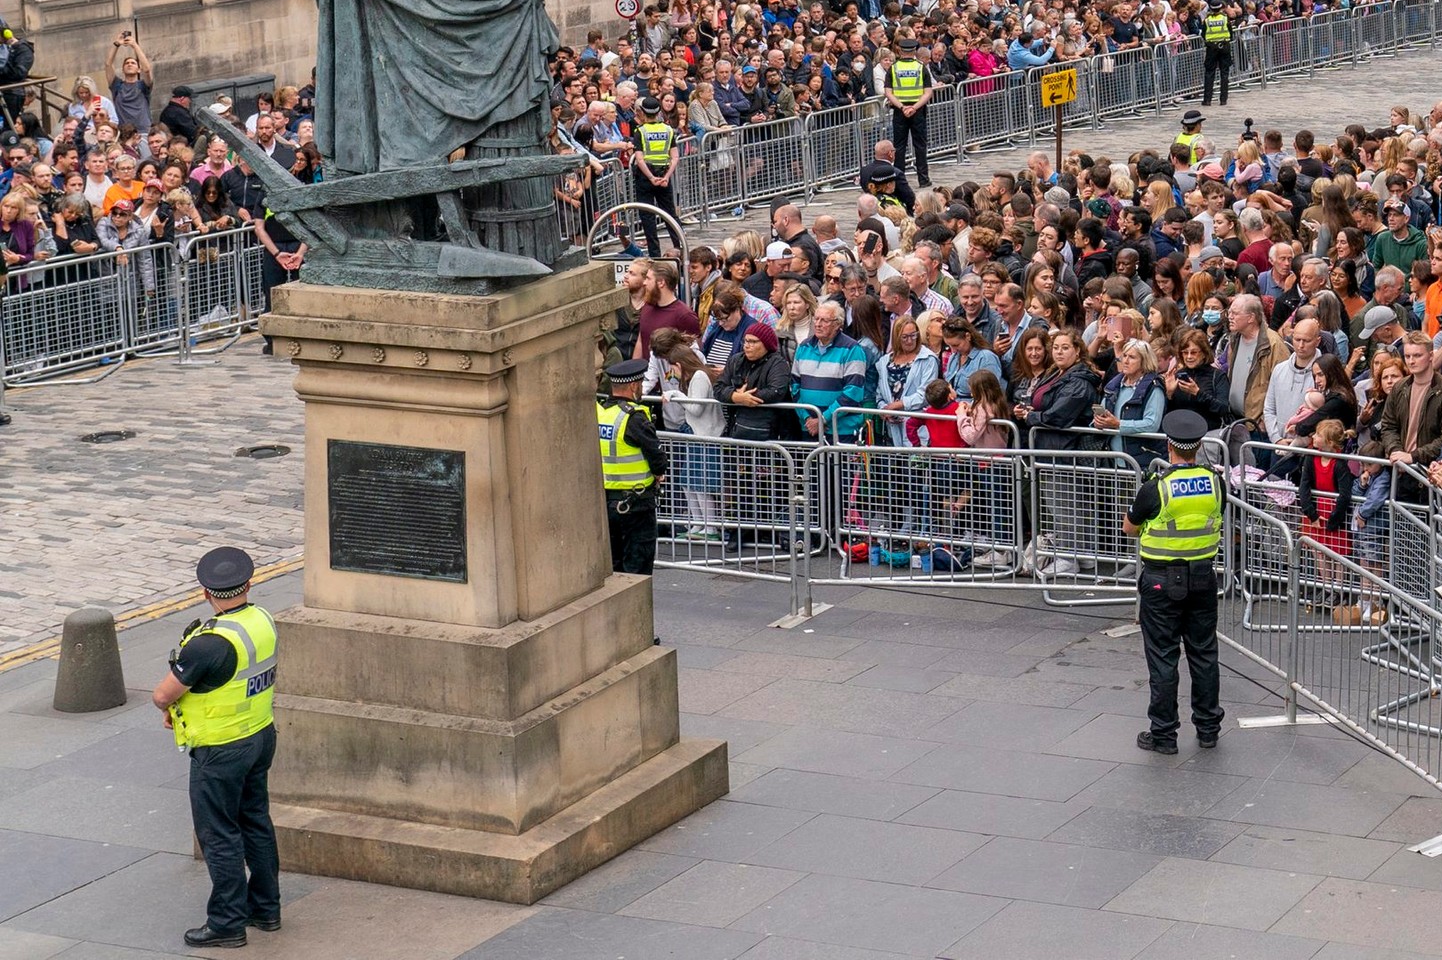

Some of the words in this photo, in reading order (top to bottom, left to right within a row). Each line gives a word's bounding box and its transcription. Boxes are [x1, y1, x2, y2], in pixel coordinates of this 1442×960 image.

[1043, 73, 1067, 85] CROSSING
[1048, 82, 1063, 91] POINT
[647, 132, 667, 140] POLICE
[1171, 479, 1212, 494] POLICE
